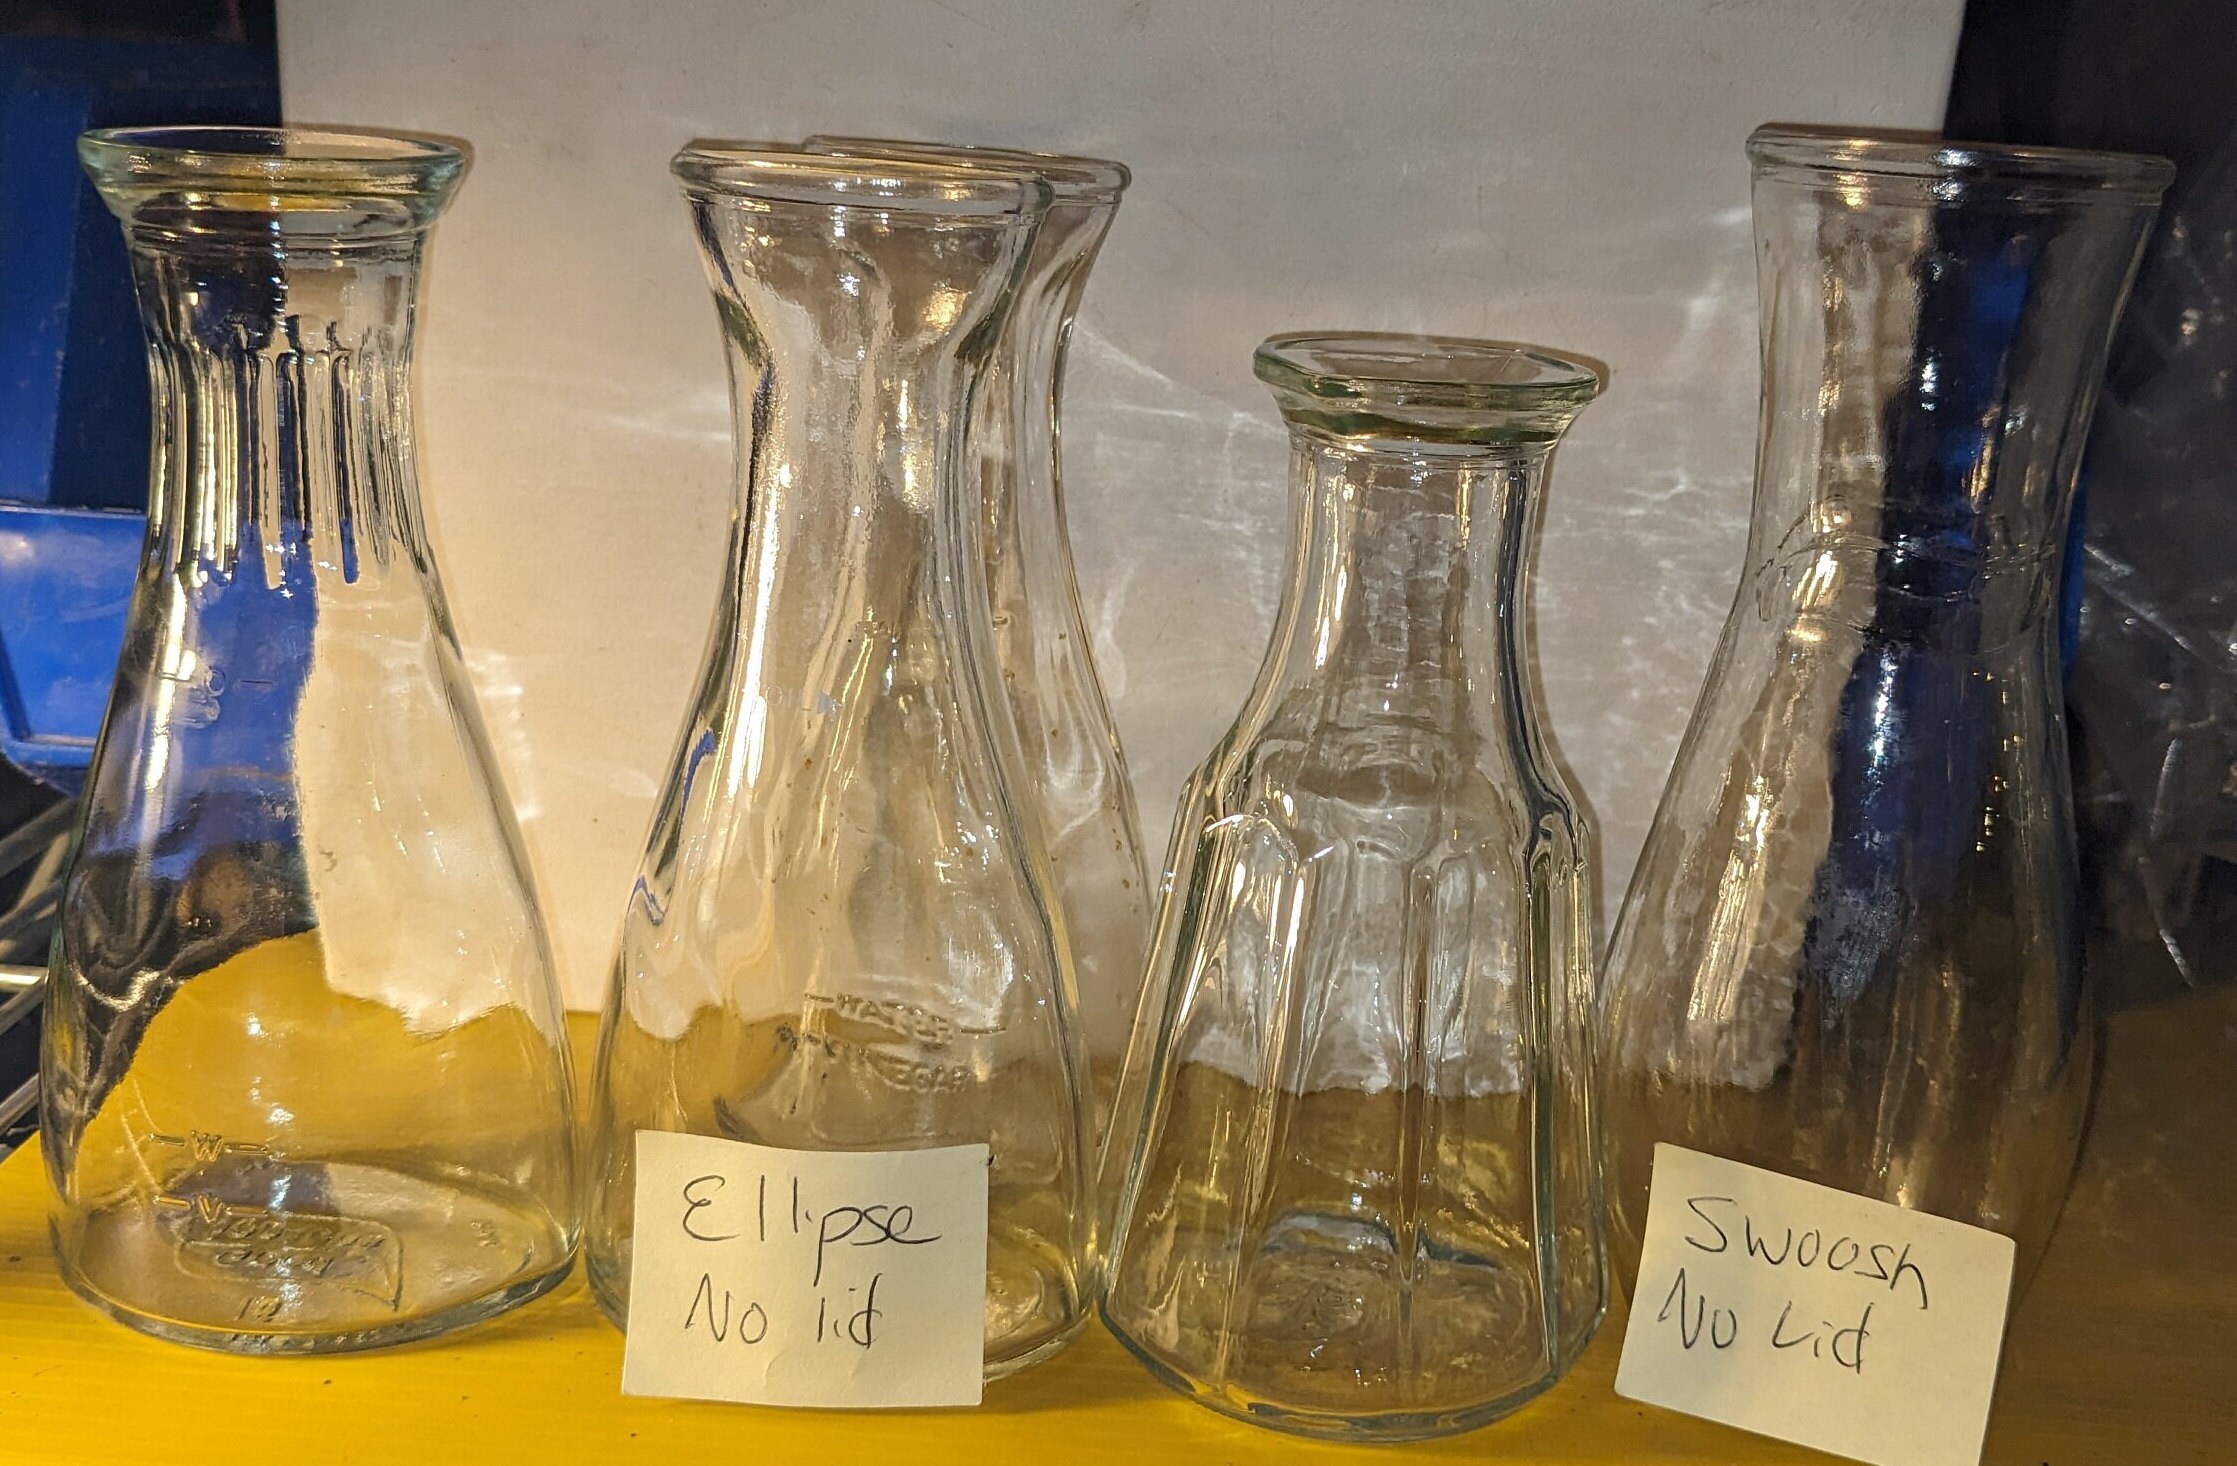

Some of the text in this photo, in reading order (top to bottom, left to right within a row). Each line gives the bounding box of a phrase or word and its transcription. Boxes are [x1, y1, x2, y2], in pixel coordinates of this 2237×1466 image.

[682, 1174, 943, 1288] Ellipse
[1684, 1196, 1928, 1310] Swoosh
[684, 1272, 883, 1350] No lid
[1656, 1267, 1875, 1375] No Lid
